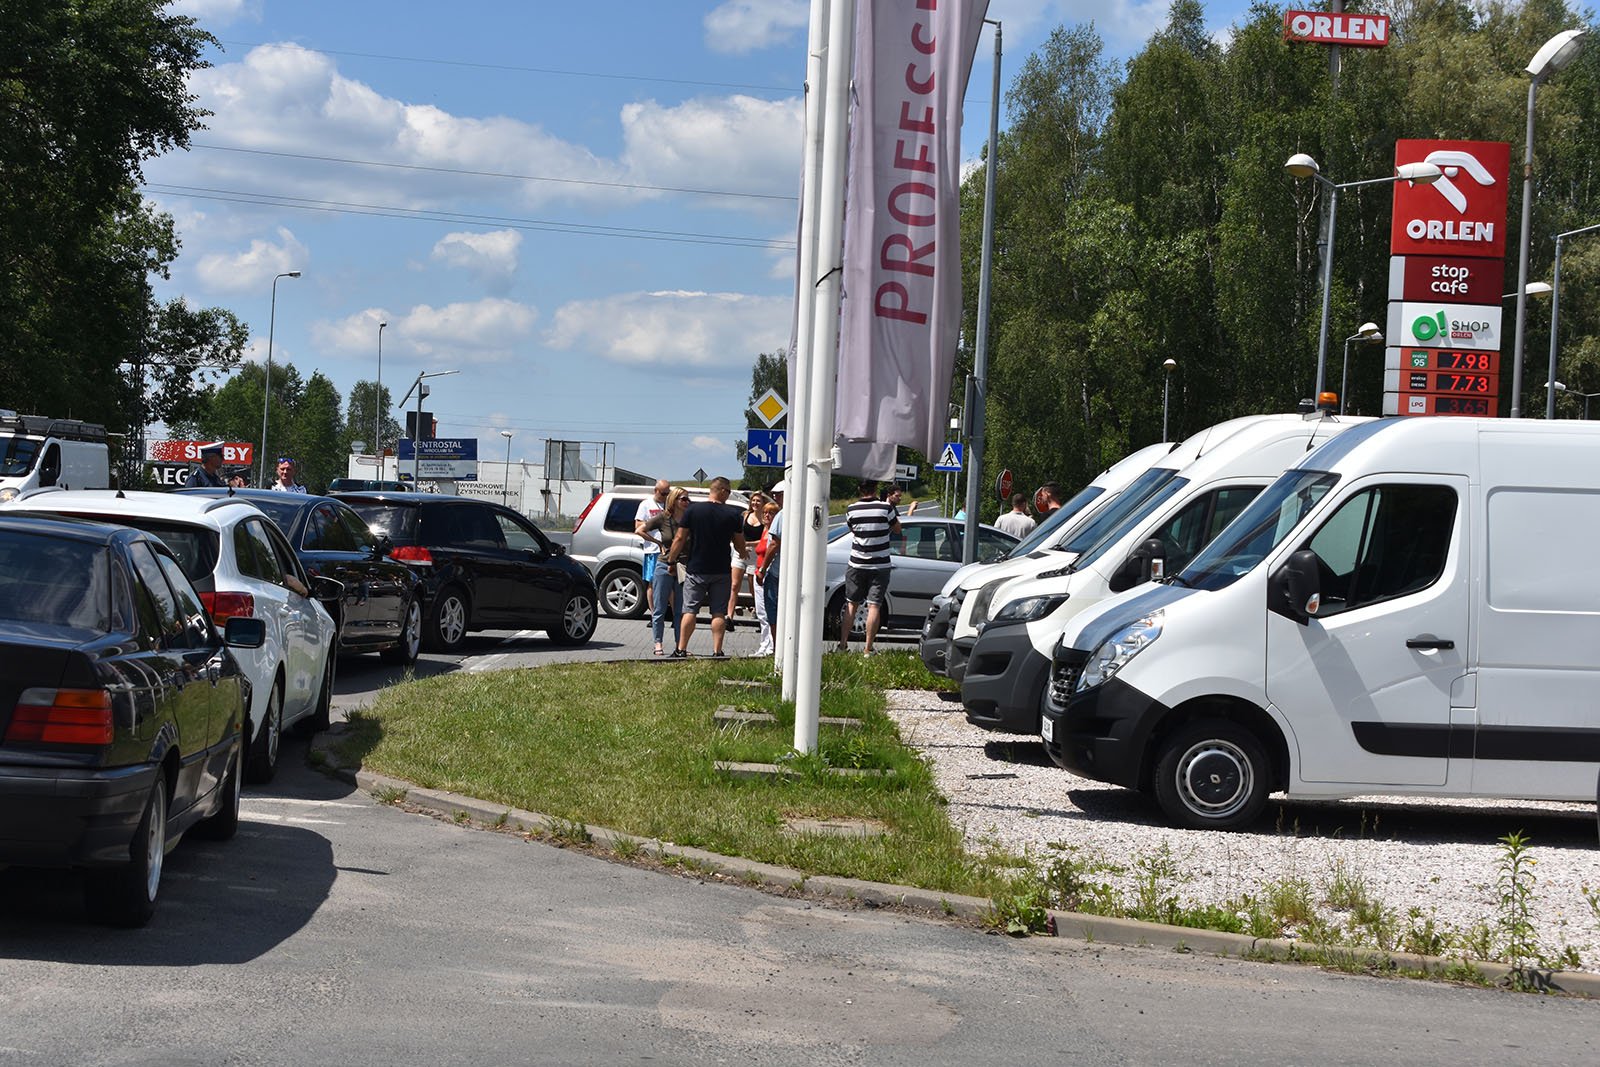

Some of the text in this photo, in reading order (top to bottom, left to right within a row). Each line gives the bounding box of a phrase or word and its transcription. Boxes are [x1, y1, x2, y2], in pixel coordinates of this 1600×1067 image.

[1291, 14, 1386, 41] ORLEN
[1406, 218, 1494, 242] ORLEN
[1431, 264, 1469, 282] stop
[1430, 279, 1469, 295] cafe
[1411, 310, 1490, 342] O! SHOP
[1413, 353, 1489, 370] 95 7.98
[1450, 375, 1488, 392] 7.73
[184, 442, 250, 461] ŚBY
